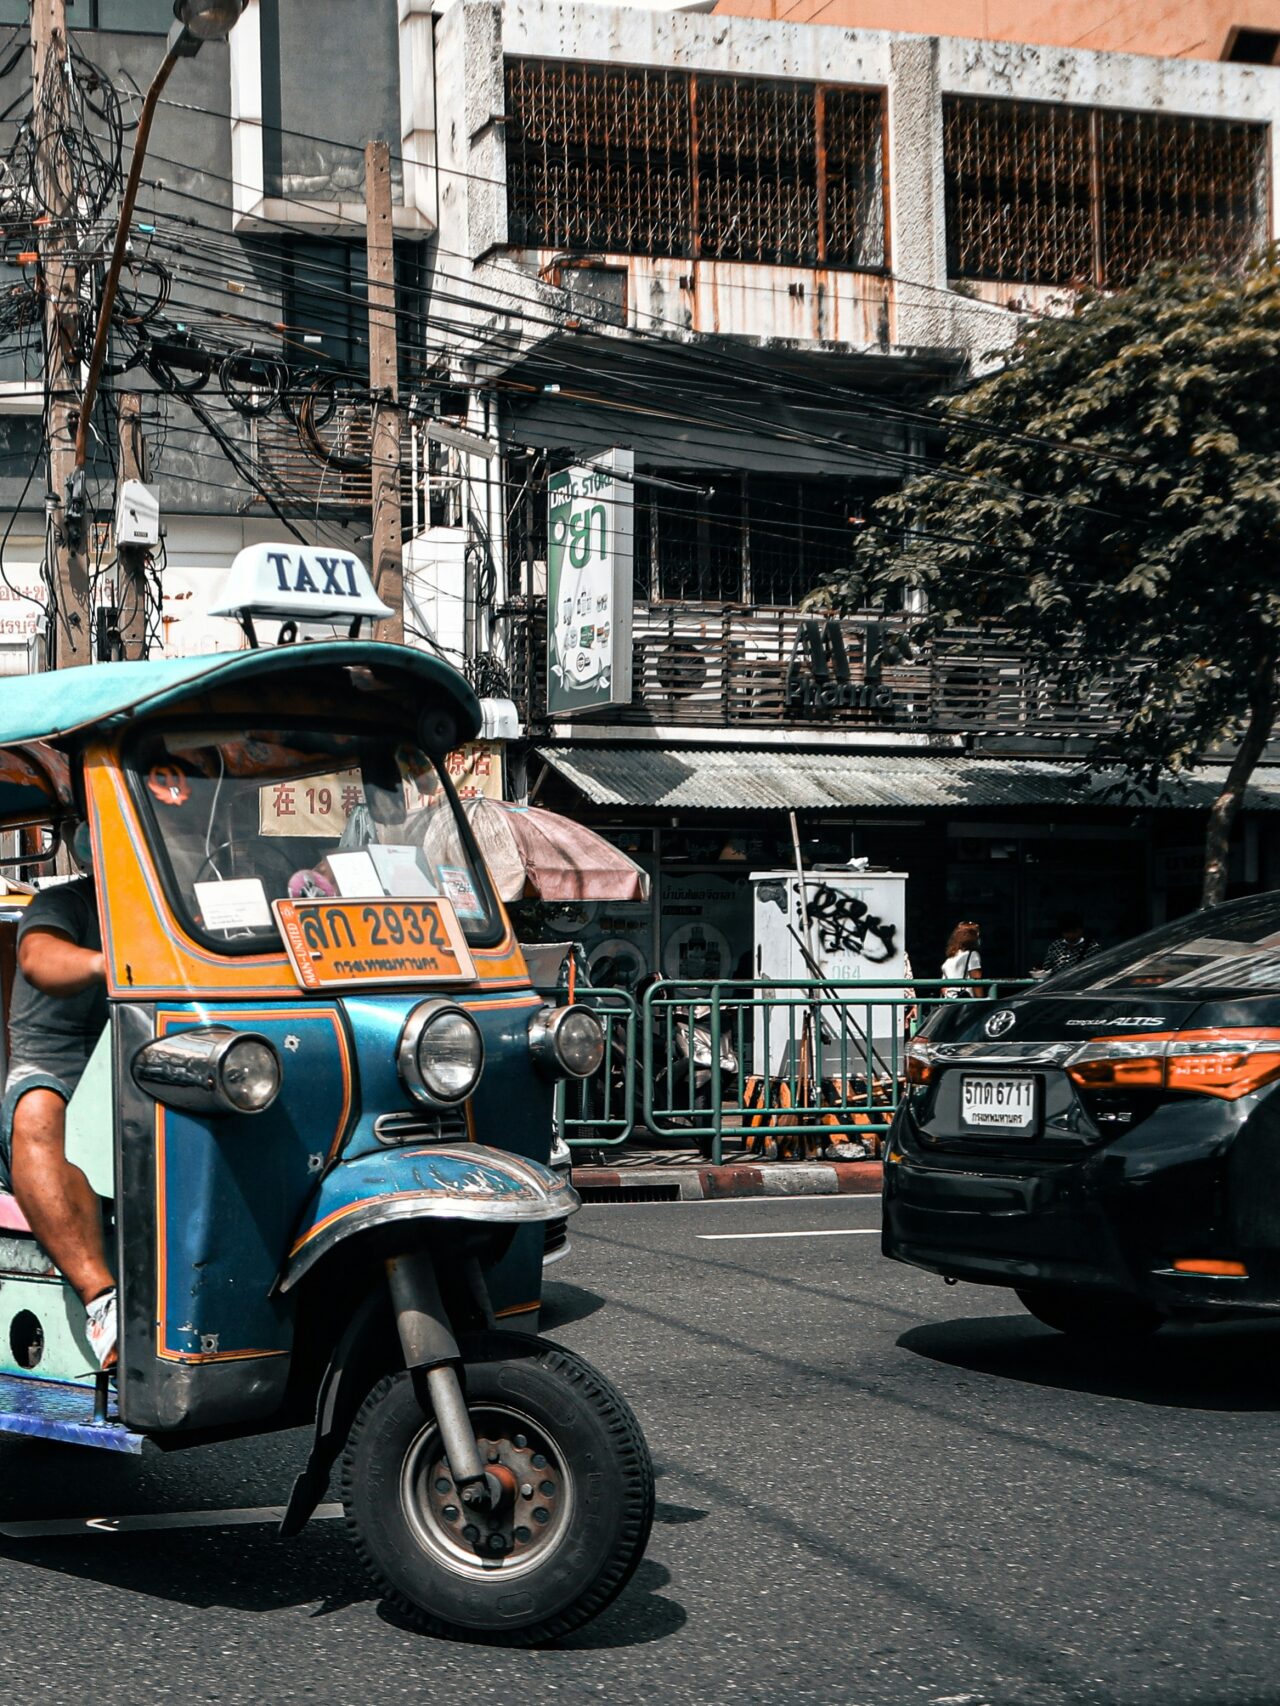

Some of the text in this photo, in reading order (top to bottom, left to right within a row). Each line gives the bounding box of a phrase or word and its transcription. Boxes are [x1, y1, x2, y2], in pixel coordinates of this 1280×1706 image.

[550, 482, 578, 509] DRUG
[569, 505, 607, 569] ยา
[267, 552, 361, 597] TAXI
[273, 784, 296, 817] 在
[306, 788, 332, 814] 19
[300, 906, 446, 948] สก 2932
[288, 922, 317, 985] MAN-UNITED
[334, 956, 439, 979] กรุงเทพมหานคร
[1107, 1016, 1166, 1026] ALTIS
[996, 1082, 1031, 1106] 6711
[971, 1113, 1023, 1125] กรุงเทพมหานคร
